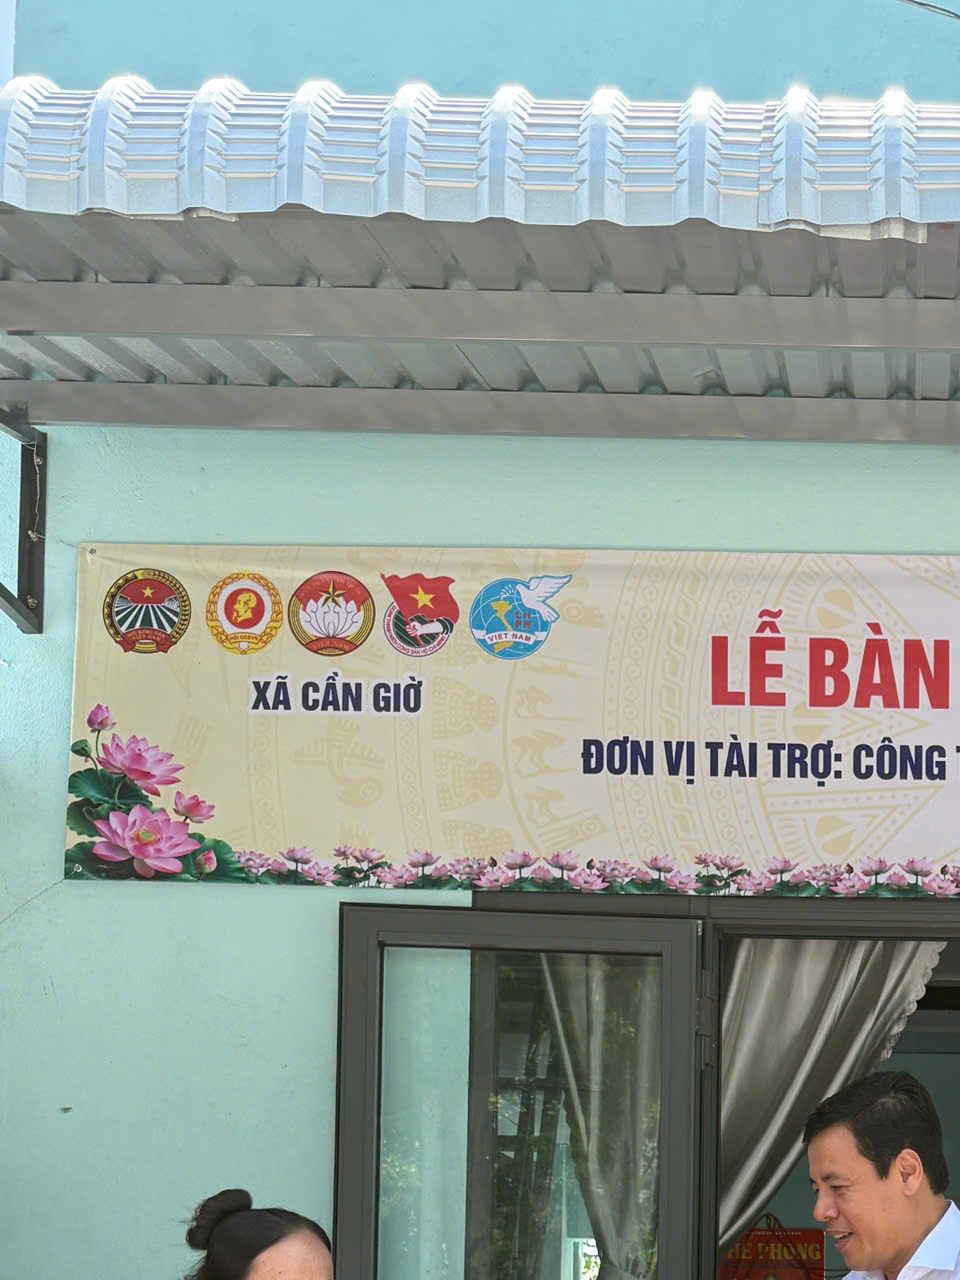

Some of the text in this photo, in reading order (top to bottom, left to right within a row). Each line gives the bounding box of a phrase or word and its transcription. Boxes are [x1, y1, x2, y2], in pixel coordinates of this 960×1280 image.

[511, 632, 532, 642] NAM
[711, 609, 786, 707] LỄ
[808, 623, 950, 709] BÀN
[251, 672, 423, 713] XÃ CẦN GIỜ
[580, 736, 653, 776] ĐƠN
[663, 741, 695, 785] VỊ
[705, 735, 757, 778] TÀI
[767, 739, 842, 787] TRỢ:
[853, 737, 945, 781] CÔNG
